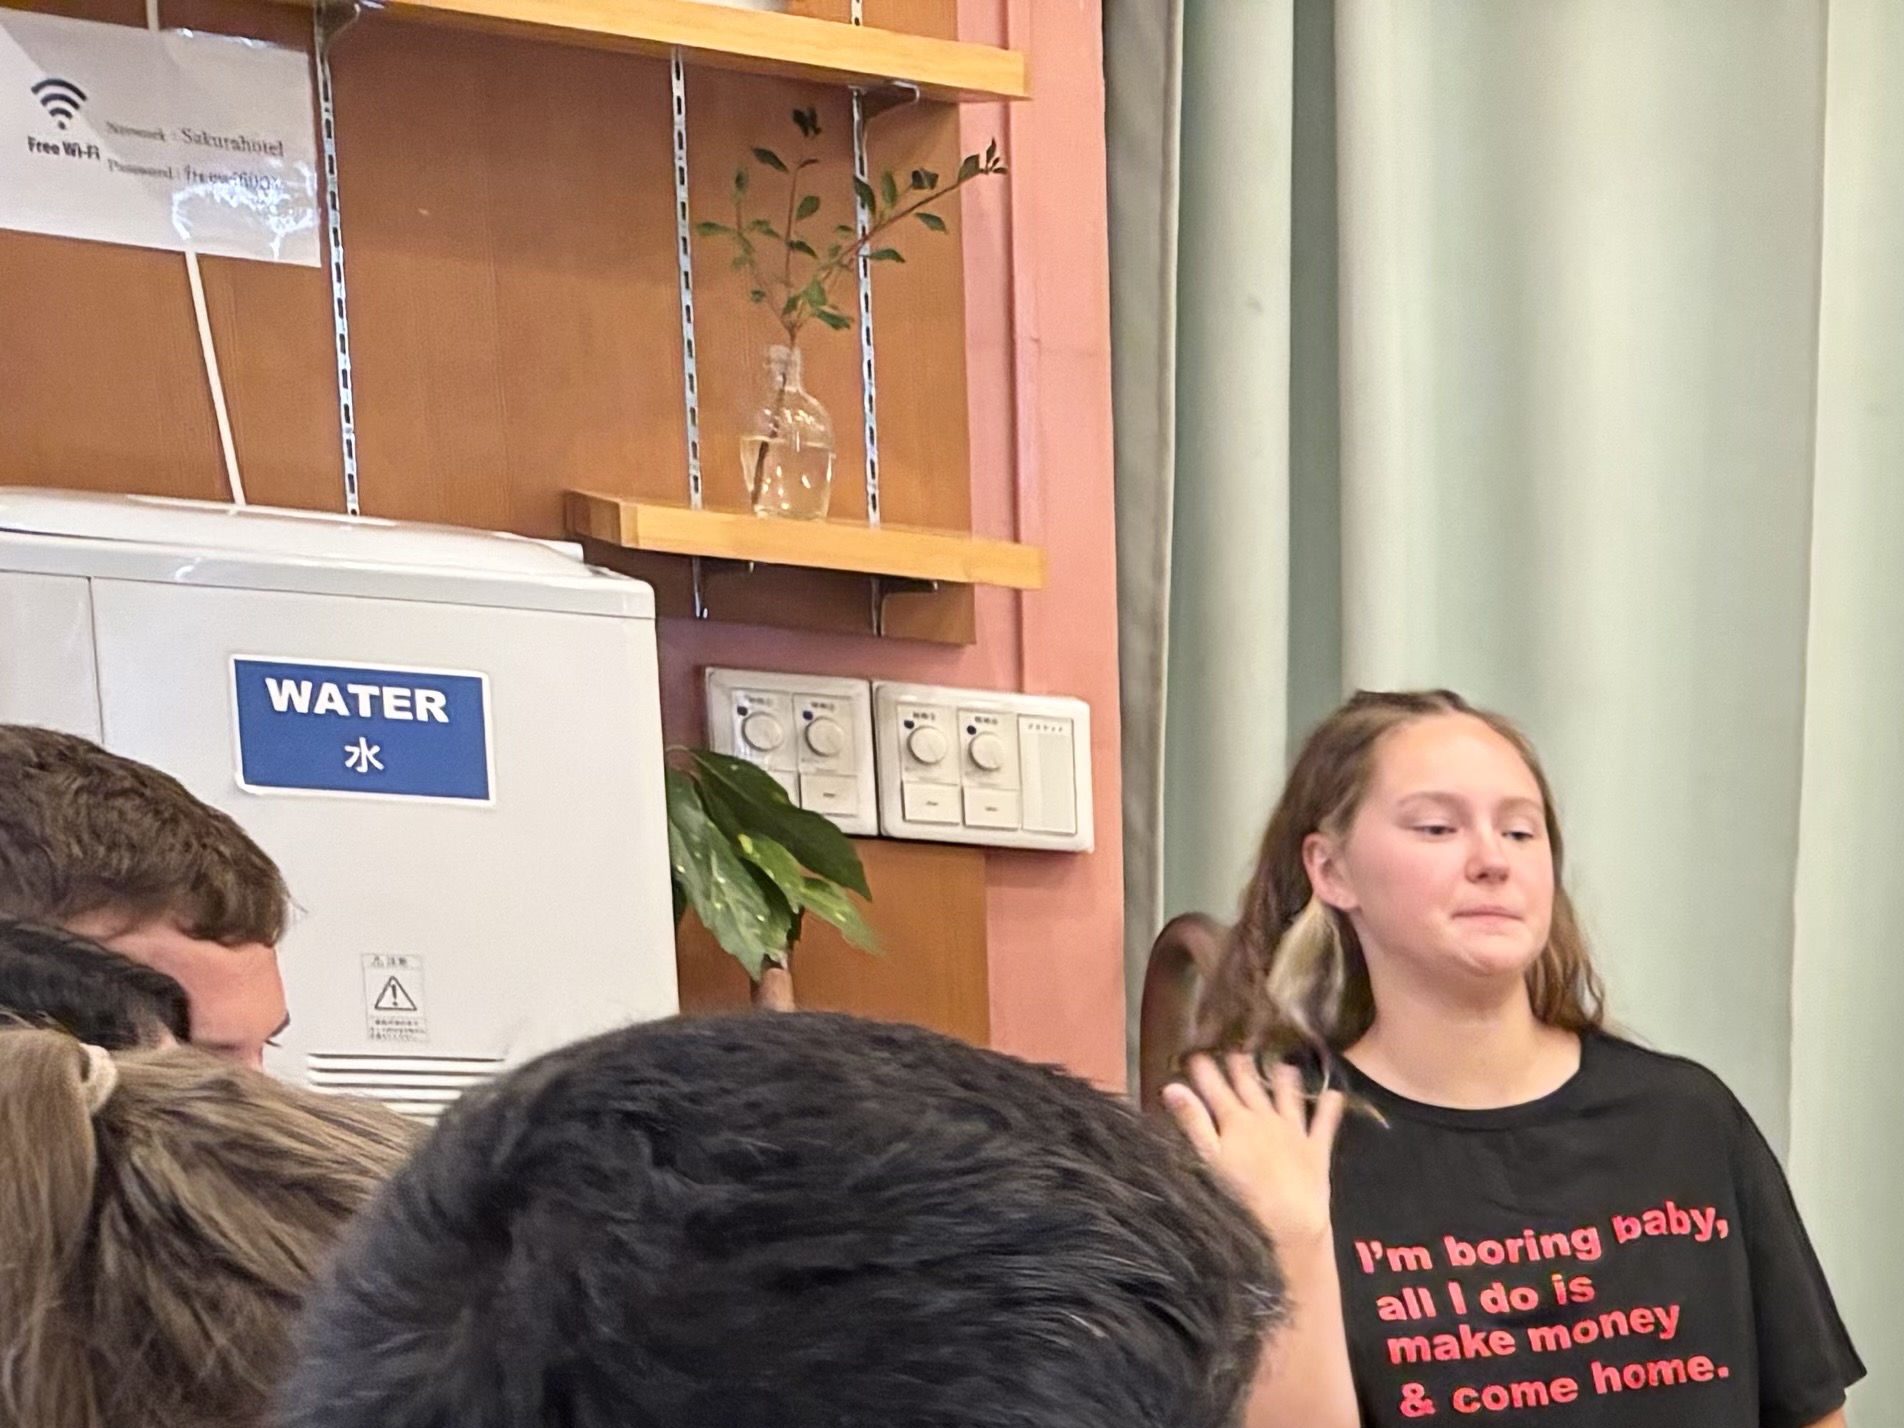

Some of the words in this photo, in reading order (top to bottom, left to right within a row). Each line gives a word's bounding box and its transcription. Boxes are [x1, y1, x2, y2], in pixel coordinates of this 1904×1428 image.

[27, 135, 60, 156] Free
[62, 140, 100, 161] Wi-Fi
[263, 675, 450, 724] WATER
[344, 735, 386, 772] 水
[1355, 1237, 1434, 1275] I'm
[1444, 1223, 1603, 1269] boring
[1611, 1199, 1730, 1246] baby,
[1375, 1284, 1437, 1323] all
[1447, 1281, 1467, 1315] I
[1480, 1281, 1539, 1313] do
[1551, 1272, 1595, 1306] is
[1386, 1324, 1516, 1366] make
[1528, 1303, 1681, 1354] money
[1399, 1381, 1436, 1419] &
[1452, 1374, 1579, 1414] come
[1590, 1352, 1731, 1396] home.
